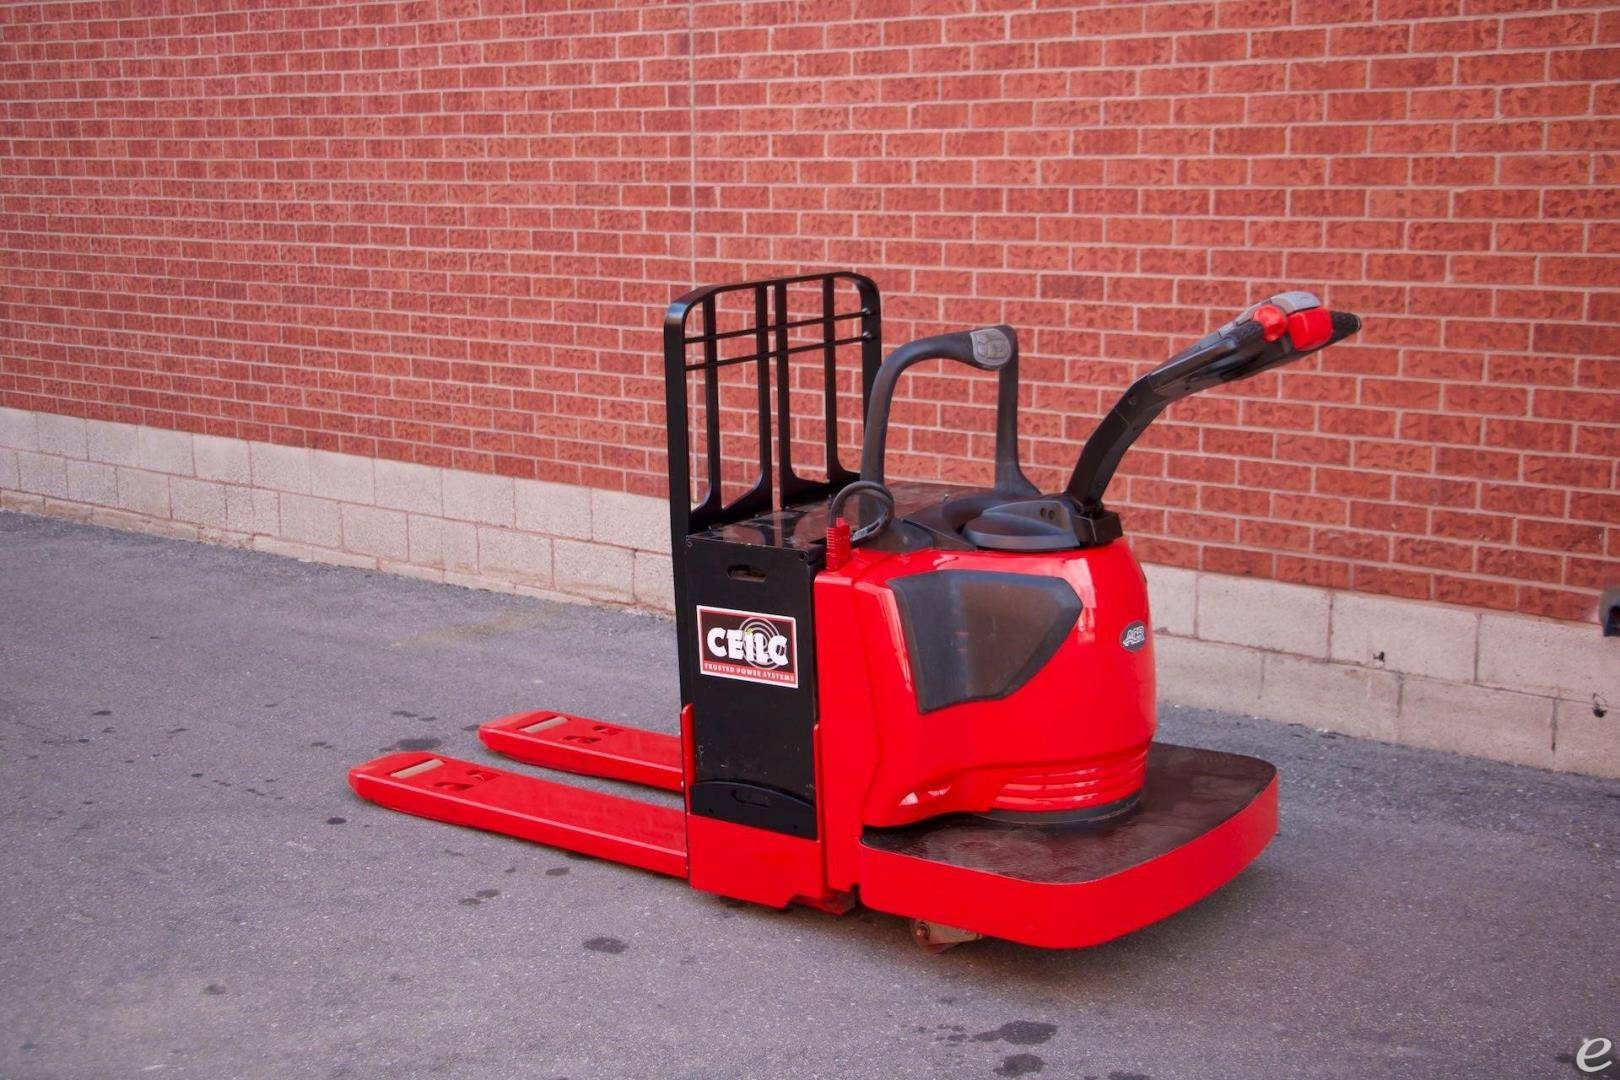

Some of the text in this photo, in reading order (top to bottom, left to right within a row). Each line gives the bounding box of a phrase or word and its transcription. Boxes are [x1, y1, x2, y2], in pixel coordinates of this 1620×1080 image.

[704, 663, 794, 681] TRUSTED POWER SYSTEMS
